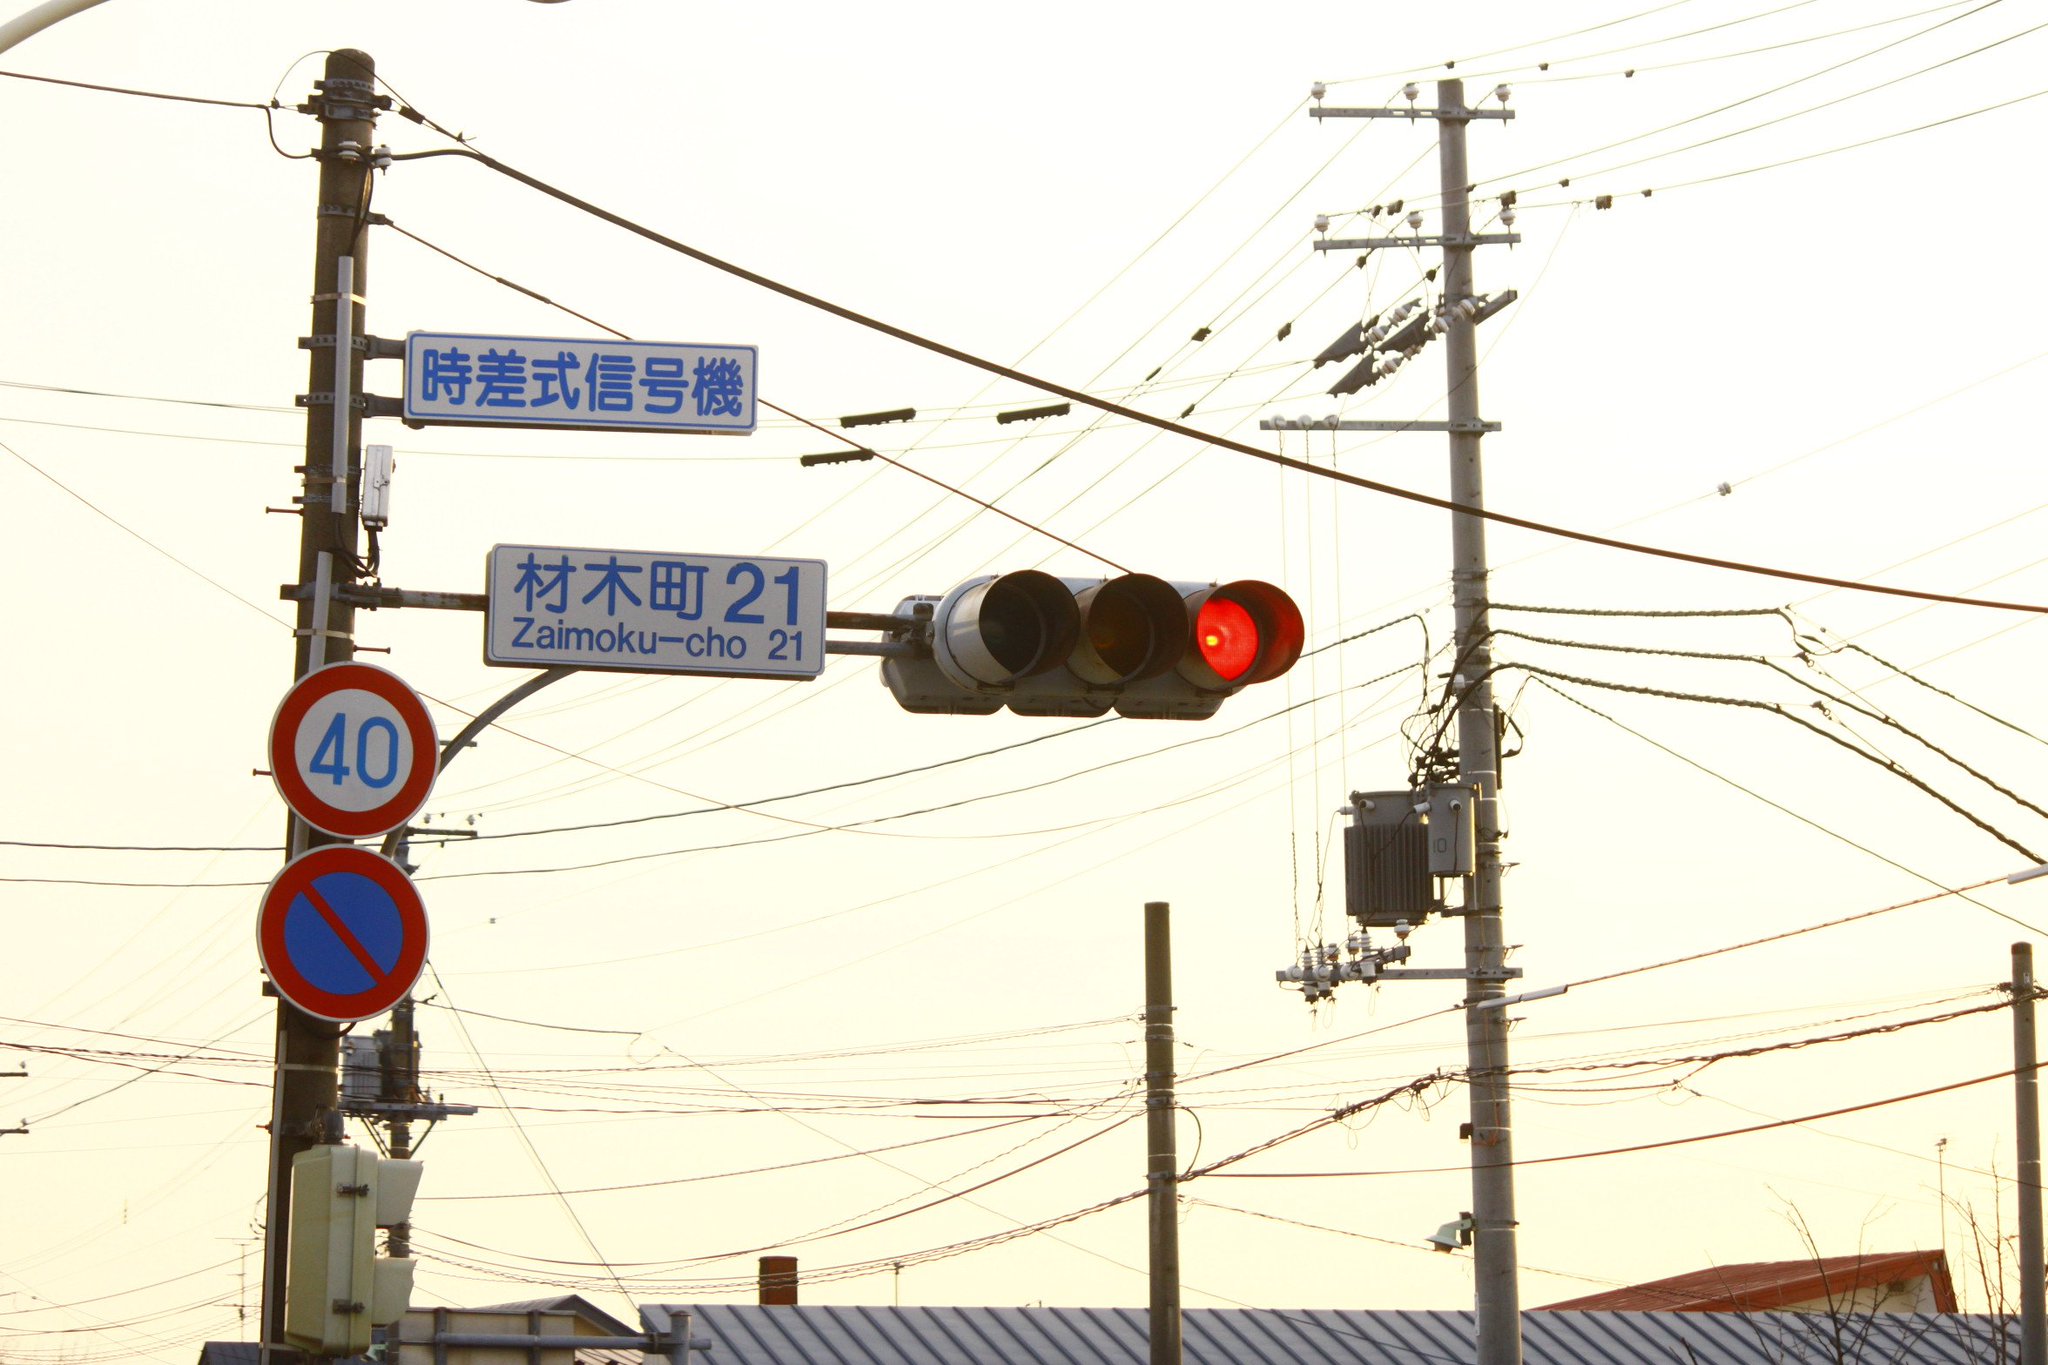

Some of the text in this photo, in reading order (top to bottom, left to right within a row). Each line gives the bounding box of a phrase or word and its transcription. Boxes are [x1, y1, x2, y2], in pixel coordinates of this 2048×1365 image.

[422, 346, 744, 417] 時差式信号機
[767, 628, 803, 661] 21
[308, 712, 400, 789] 40
